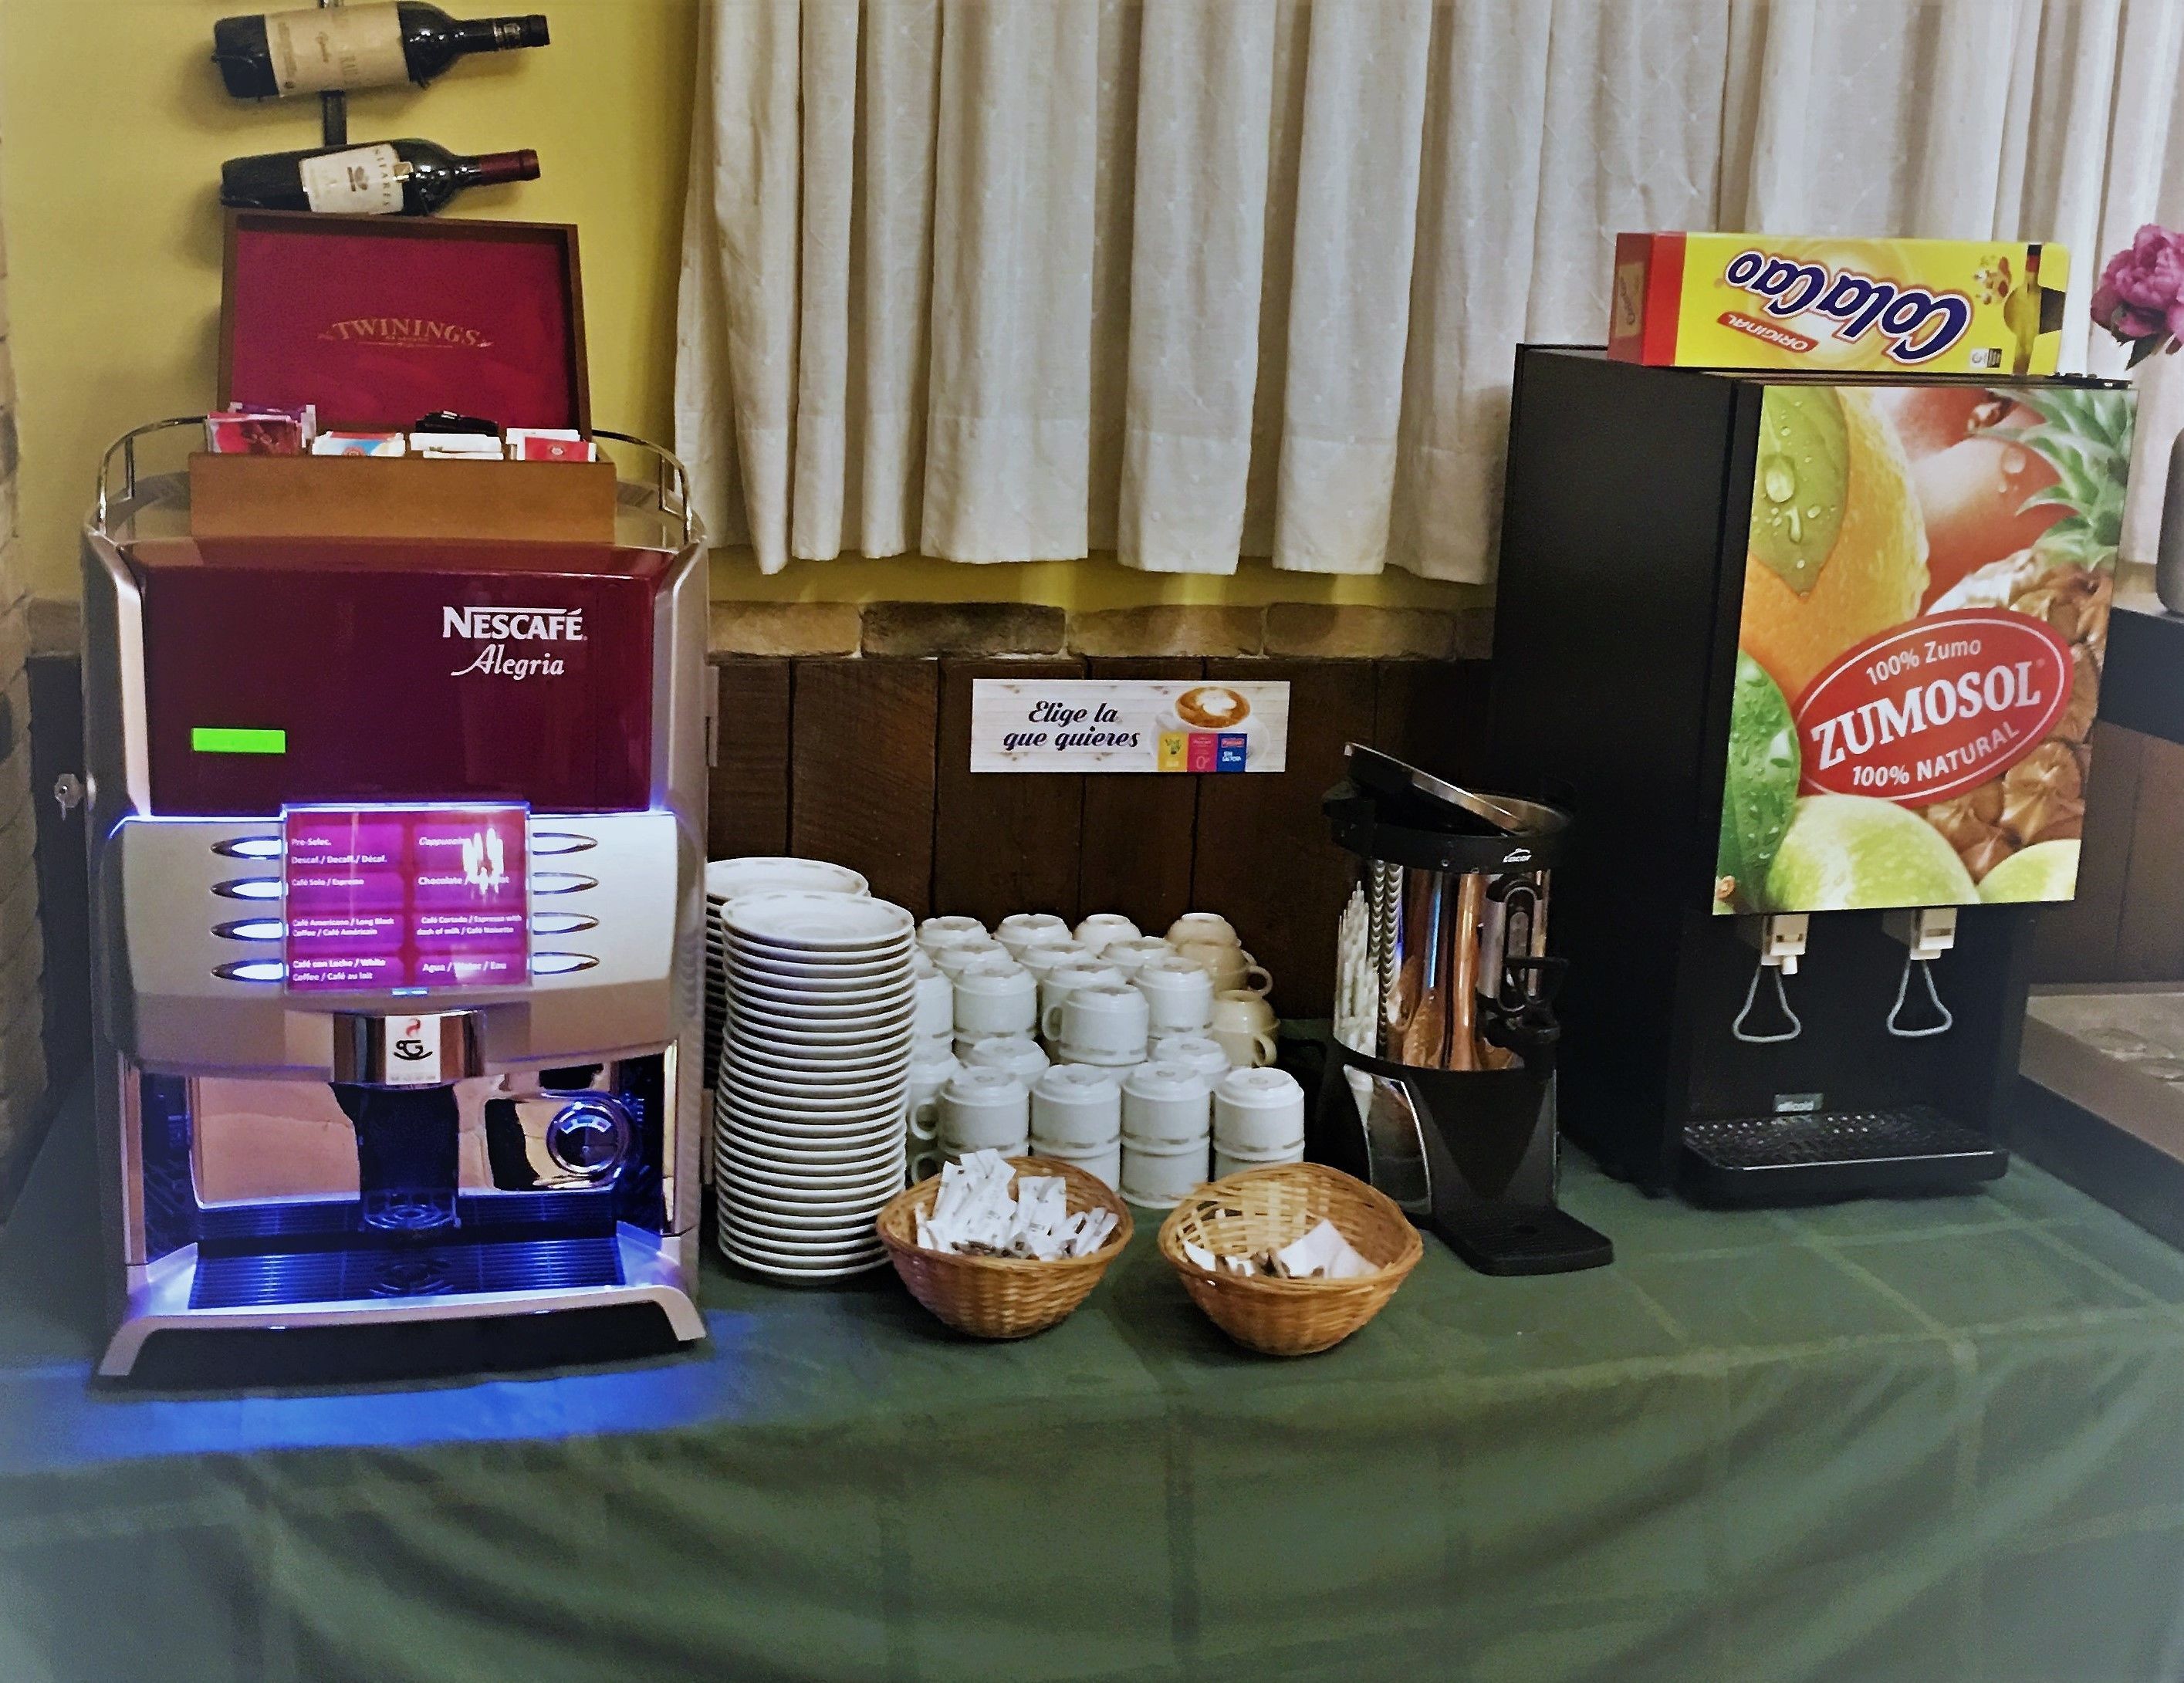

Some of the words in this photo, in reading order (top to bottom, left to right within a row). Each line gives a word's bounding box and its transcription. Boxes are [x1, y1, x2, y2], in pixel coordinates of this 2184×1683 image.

[1723, 248, 1973, 365] ColaCao
[332, 318, 482, 346] TWININGS
[1728, 313, 1809, 350] ORIGINAL
[442, 606, 583, 640] NESCAFÉ
[450, 644, 565, 681] Alegria
[1865, 649, 1920, 686] 100%
[1923, 639, 1982, 664] Zumo
[1028, 700, 1088, 728] Elige
[1094, 702, 1120, 723] la
[1810, 660, 2041, 771] ZUMOSOL
[1003, 732, 1048, 752] que
[1054, 725, 1141, 752] quieres
[1852, 764, 1910, 787] 100%
[1916, 721, 2020, 782] NATURAL
